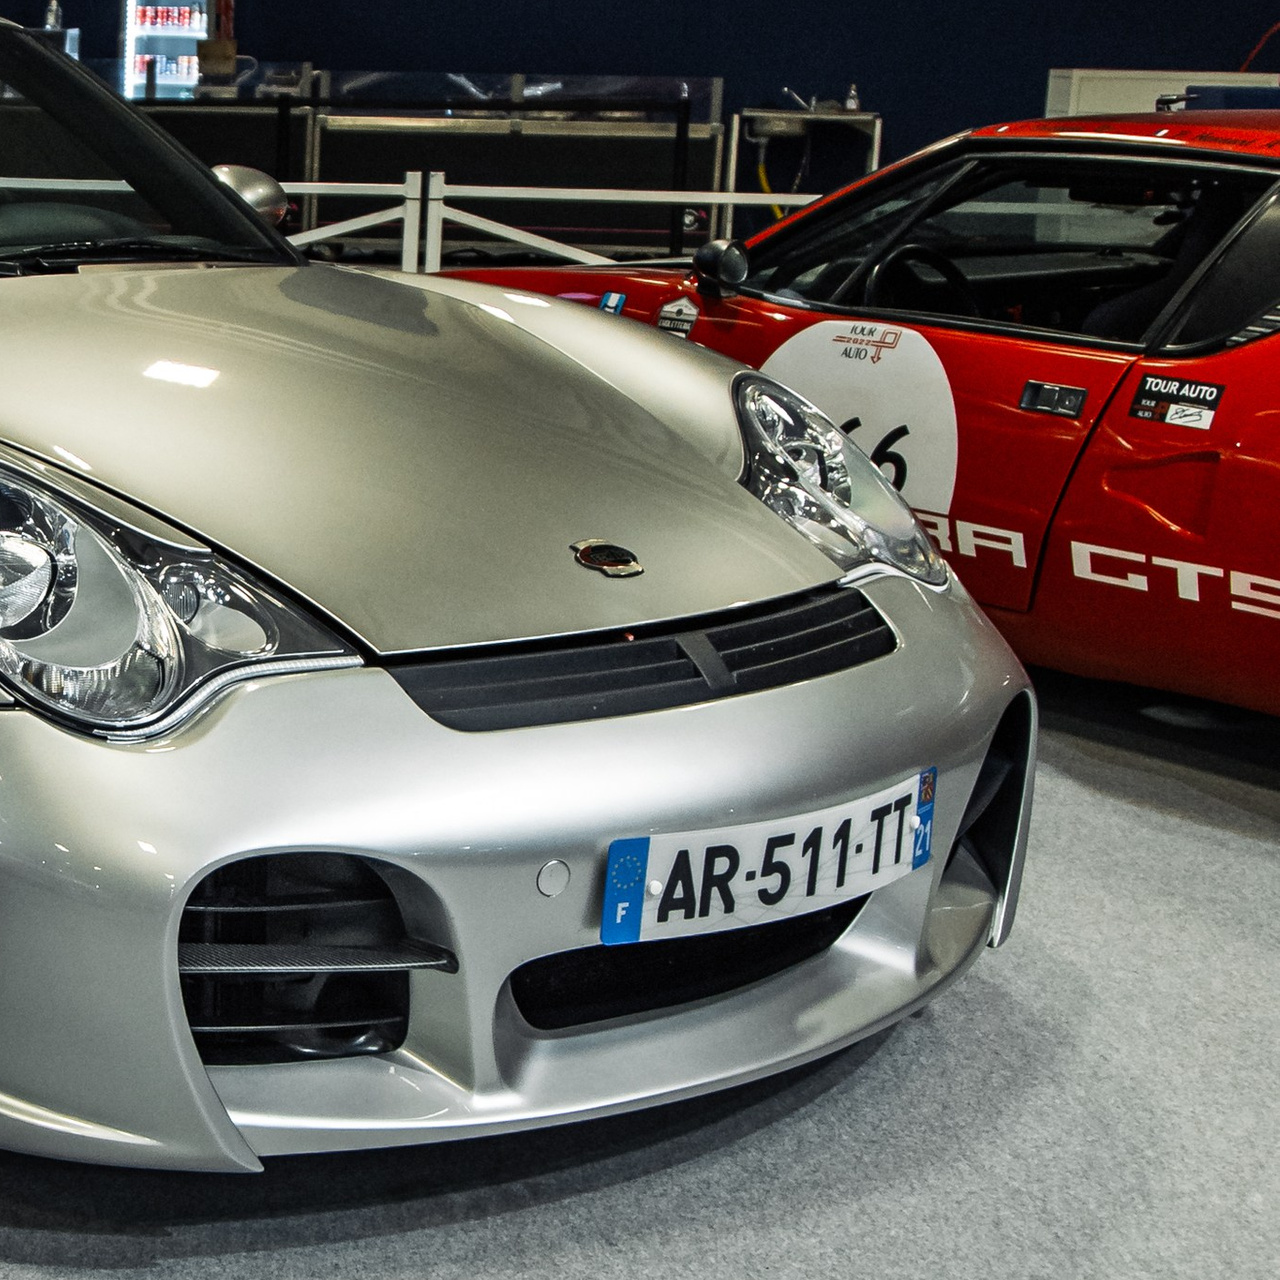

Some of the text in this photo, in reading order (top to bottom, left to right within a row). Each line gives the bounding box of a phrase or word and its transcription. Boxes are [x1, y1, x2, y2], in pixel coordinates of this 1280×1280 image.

[841, 347, 868, 360] AUTO
[1145, 377, 1217, 401] TOUR AUTO
[840, 417, 910, 493] 6
[1071, 541, 1280, 619] GTS
[915, 819, 931, 857] 21
[657, 793, 912, 923] AR-511-TT
[616, 902, 629, 923] F
